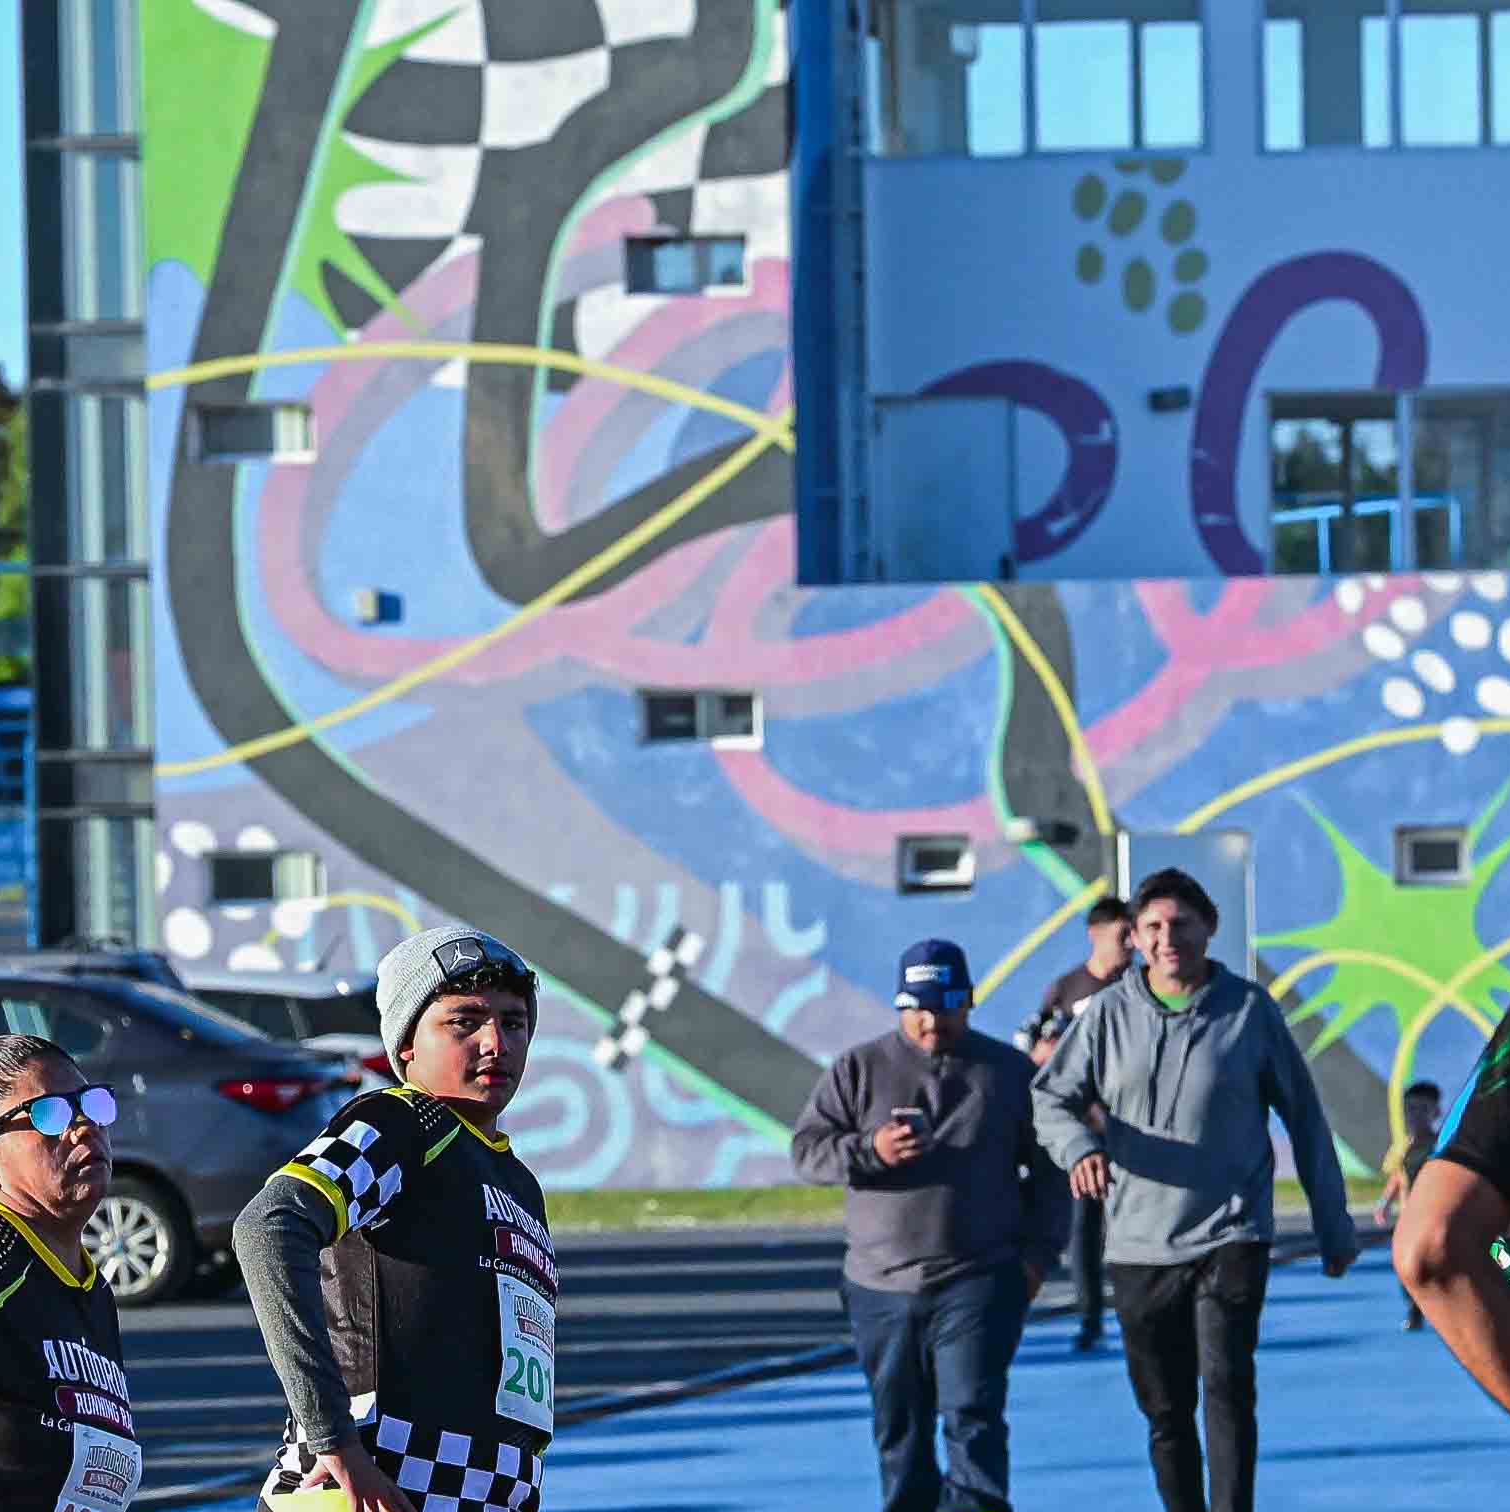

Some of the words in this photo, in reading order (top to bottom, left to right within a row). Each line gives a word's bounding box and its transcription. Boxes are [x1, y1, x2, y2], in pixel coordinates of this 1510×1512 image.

[479, 1255, 491, 1268] La
[544, 1256, 559, 1288] RAC
[43, 1337, 131, 1409] AUTÓDRO
[40, 1412, 54, 1427] La
[74, 1392, 120, 1424] RUNNING
[119, 1405, 134, 1435] RA
